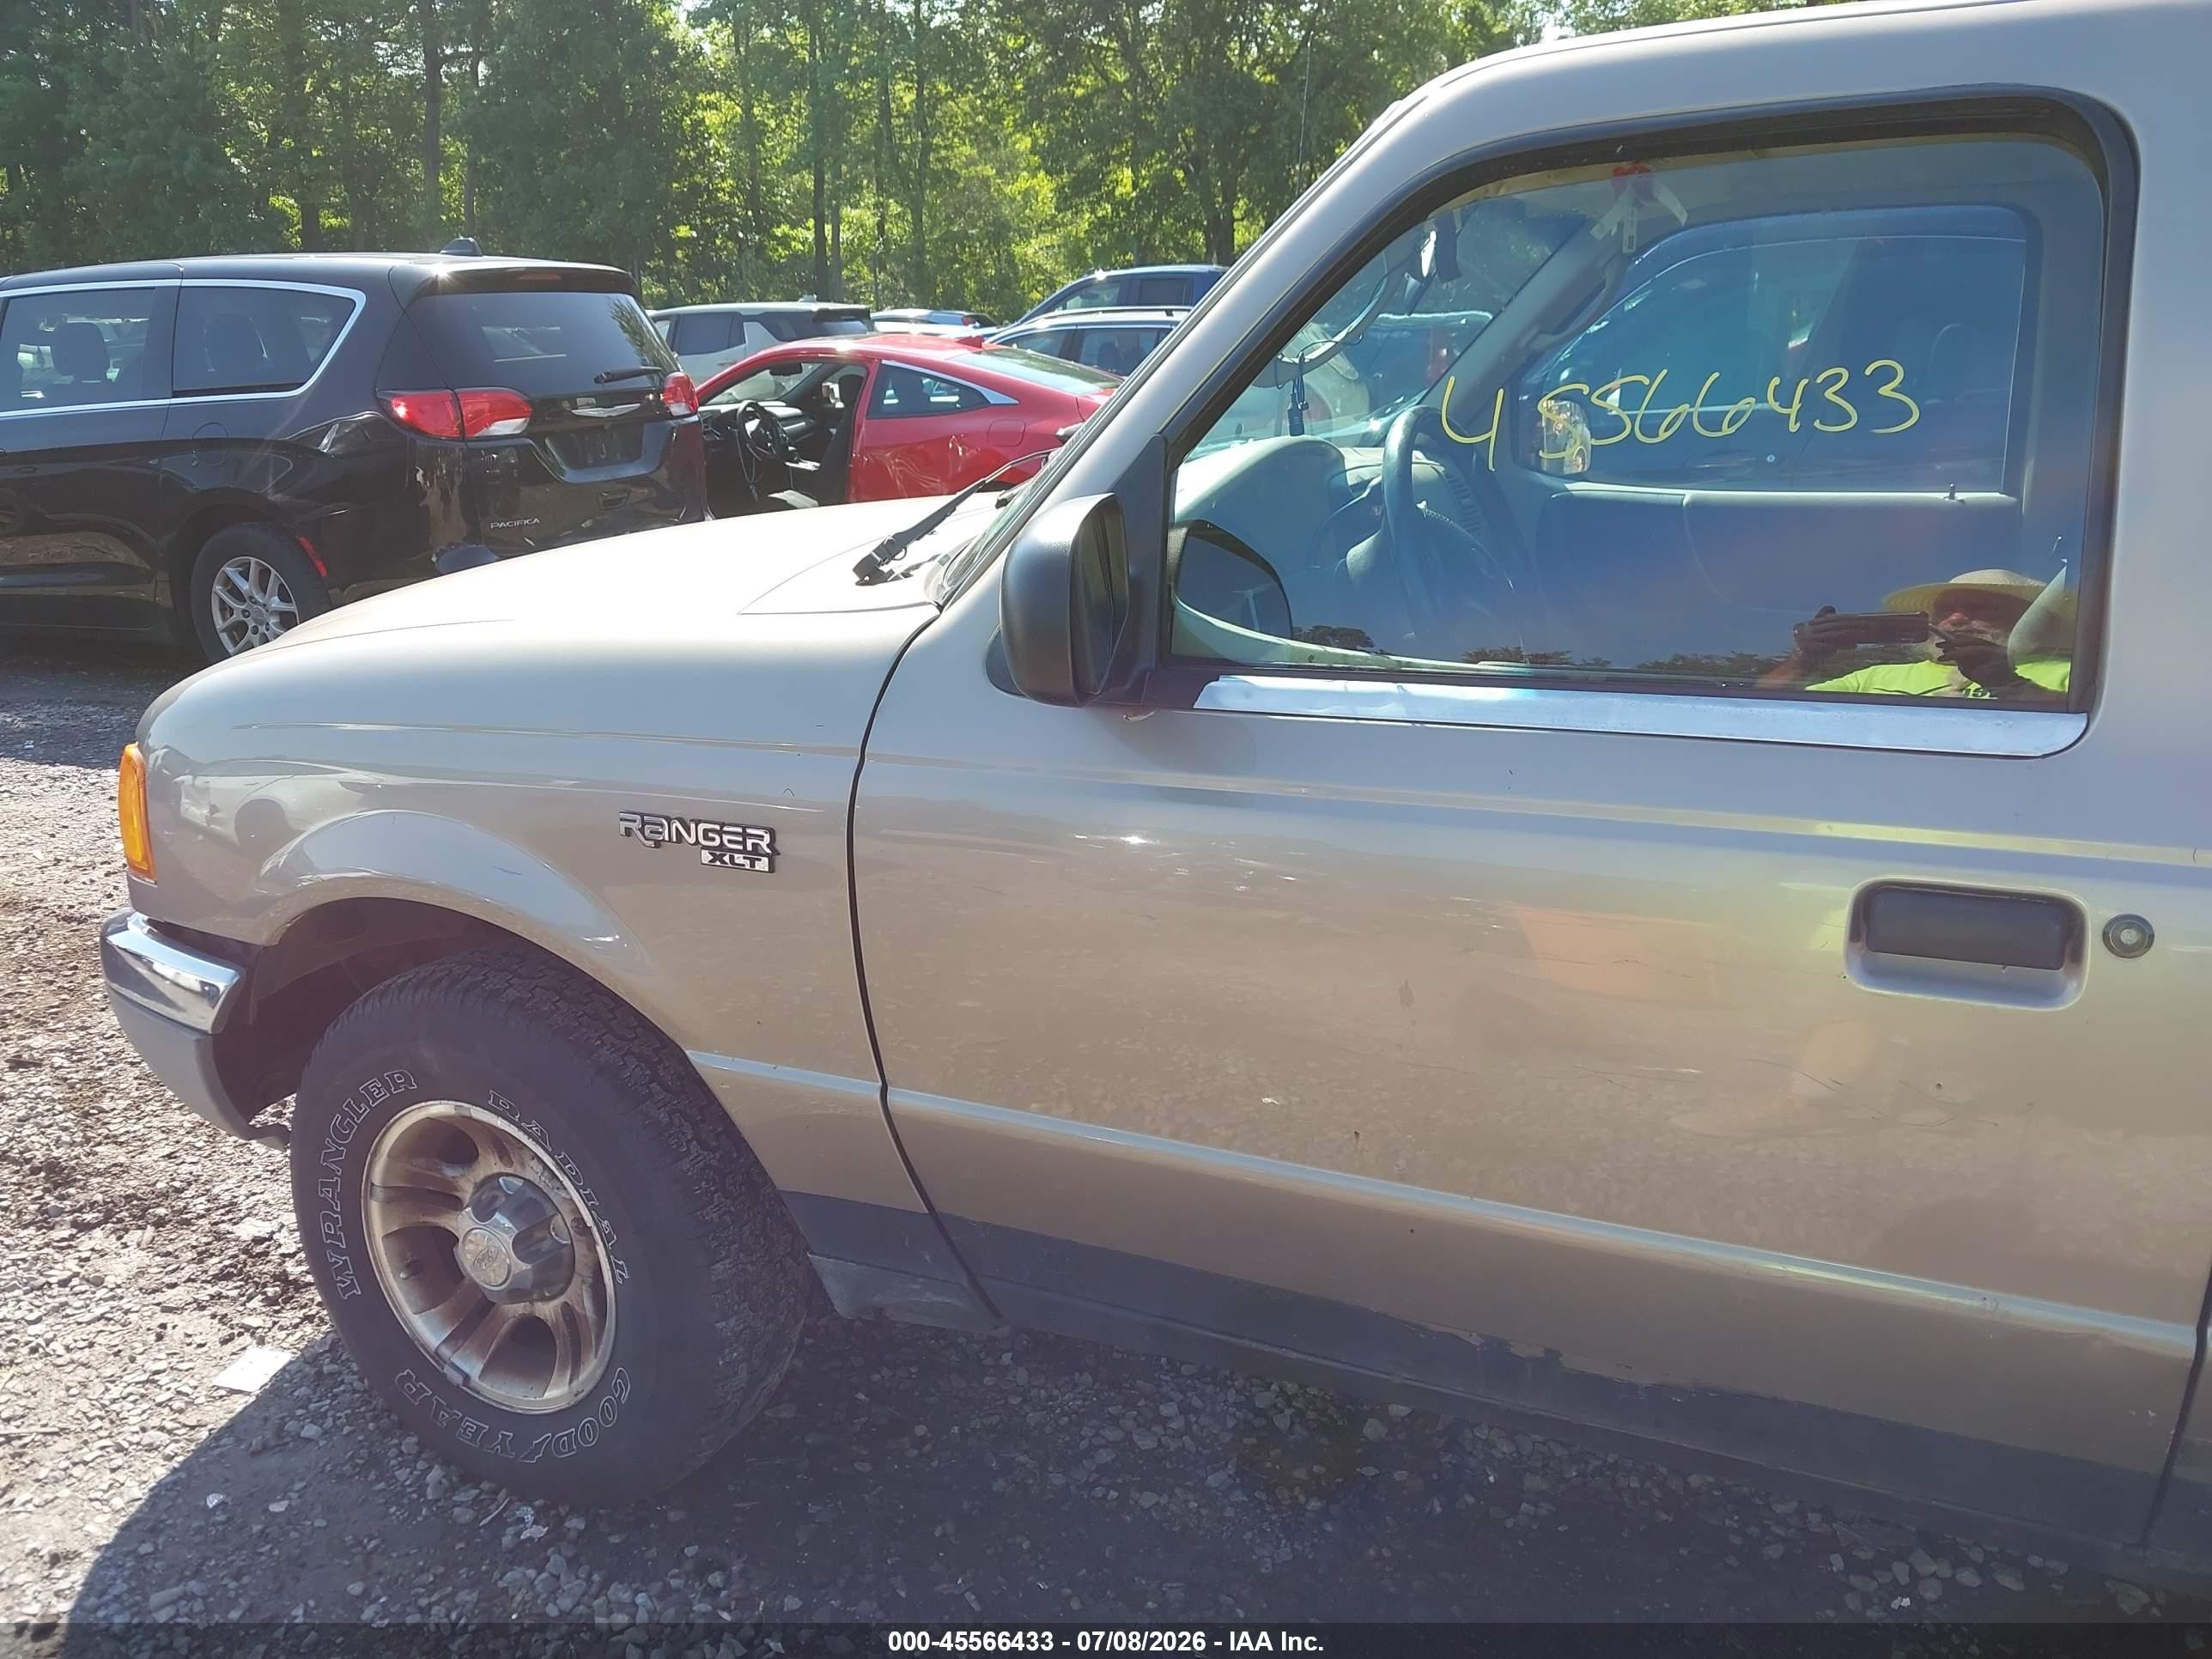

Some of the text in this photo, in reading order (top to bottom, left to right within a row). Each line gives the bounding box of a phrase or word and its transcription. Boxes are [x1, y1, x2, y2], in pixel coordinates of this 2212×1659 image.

[1441, 359, 1921, 471] 45566433
[490, 518, 540, 530] PACIFICA
[618, 811, 778, 855] RANGER
[705, 849, 765, 871] XLT
[319, 1069, 417, 1299] WRANGLER
[488, 1089, 629, 1285] RADIAL
